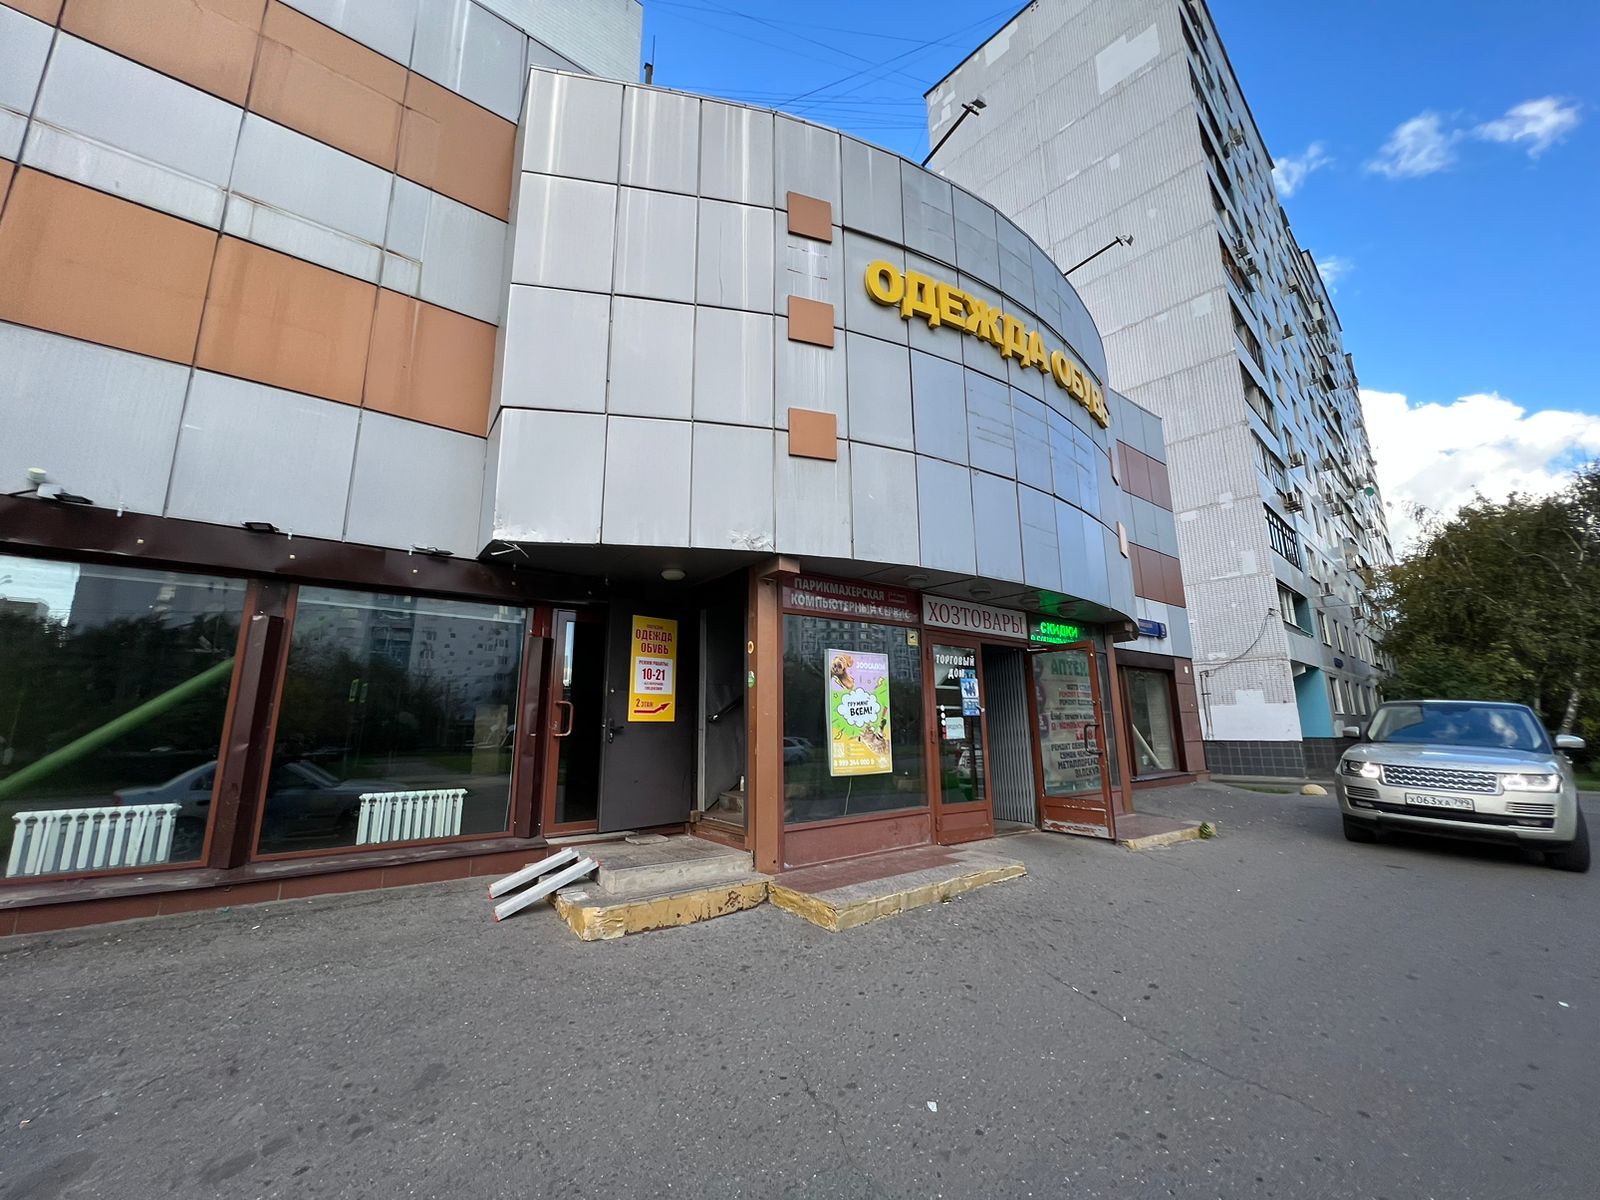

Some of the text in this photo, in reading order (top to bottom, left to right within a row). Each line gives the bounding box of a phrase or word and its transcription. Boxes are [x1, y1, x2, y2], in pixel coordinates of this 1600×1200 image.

[865, 260, 1050, 374] ОДЕЖДА
[794, 577, 885, 600] ПАРИКМАХЕРСКАЯ
[791, 593, 877, 616] КОМПЬЮТЕРНЫЙ
[878, 606, 912, 620] СЕРВИС
[927, 601, 1024, 635] ХОЗТОВАРЫ
[635, 628, 673, 643] ОДЕЖДА
[1040, 621, 1078, 639] СКИДКИ
[640, 642, 669, 655] ОБУВЬ
[935, 654, 975, 667] ТОРГОВЫЙ
[641, 668, 666, 681] 10-21
[947, 667, 965, 680] ДОМ
[635, 698, 641, 708] 2
[849, 706, 873, 717] ВСЕМ!
